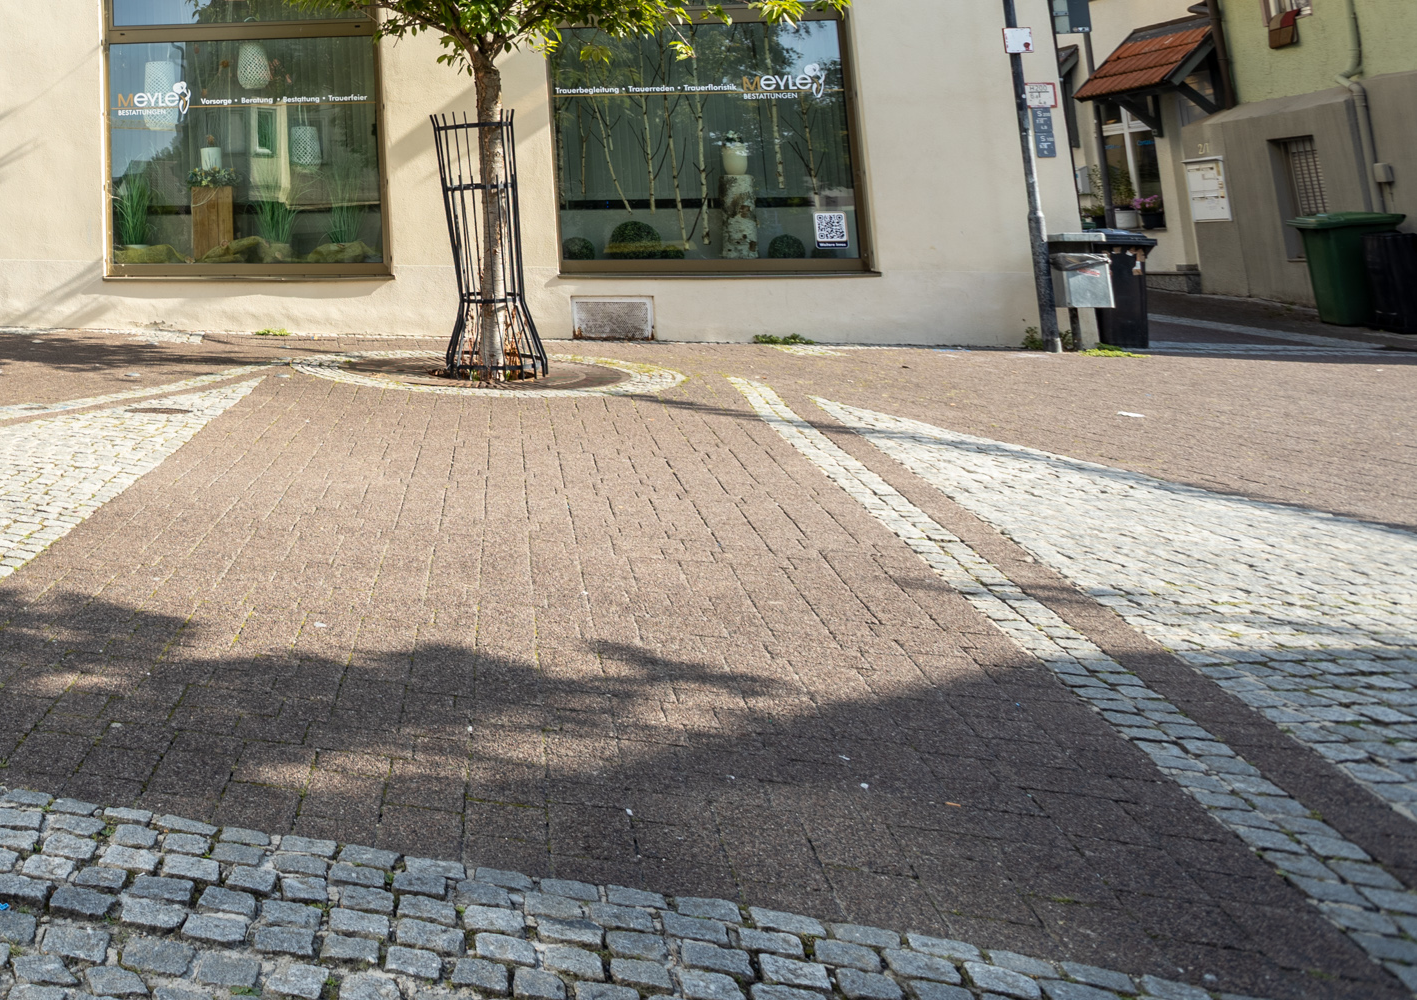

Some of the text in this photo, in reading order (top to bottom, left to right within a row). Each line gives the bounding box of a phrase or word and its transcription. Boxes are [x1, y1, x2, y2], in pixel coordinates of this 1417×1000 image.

[555, 83, 737, 96] Trauerbegleitung Trauerreden Trauerfloristik
[200, 98, 232, 106] Vorsorge
[241, 96, 273, 104] Beratung
[282, 95, 320, 103] Bestattung
[743, 92, 798, 100] BESTATTUNGEN
